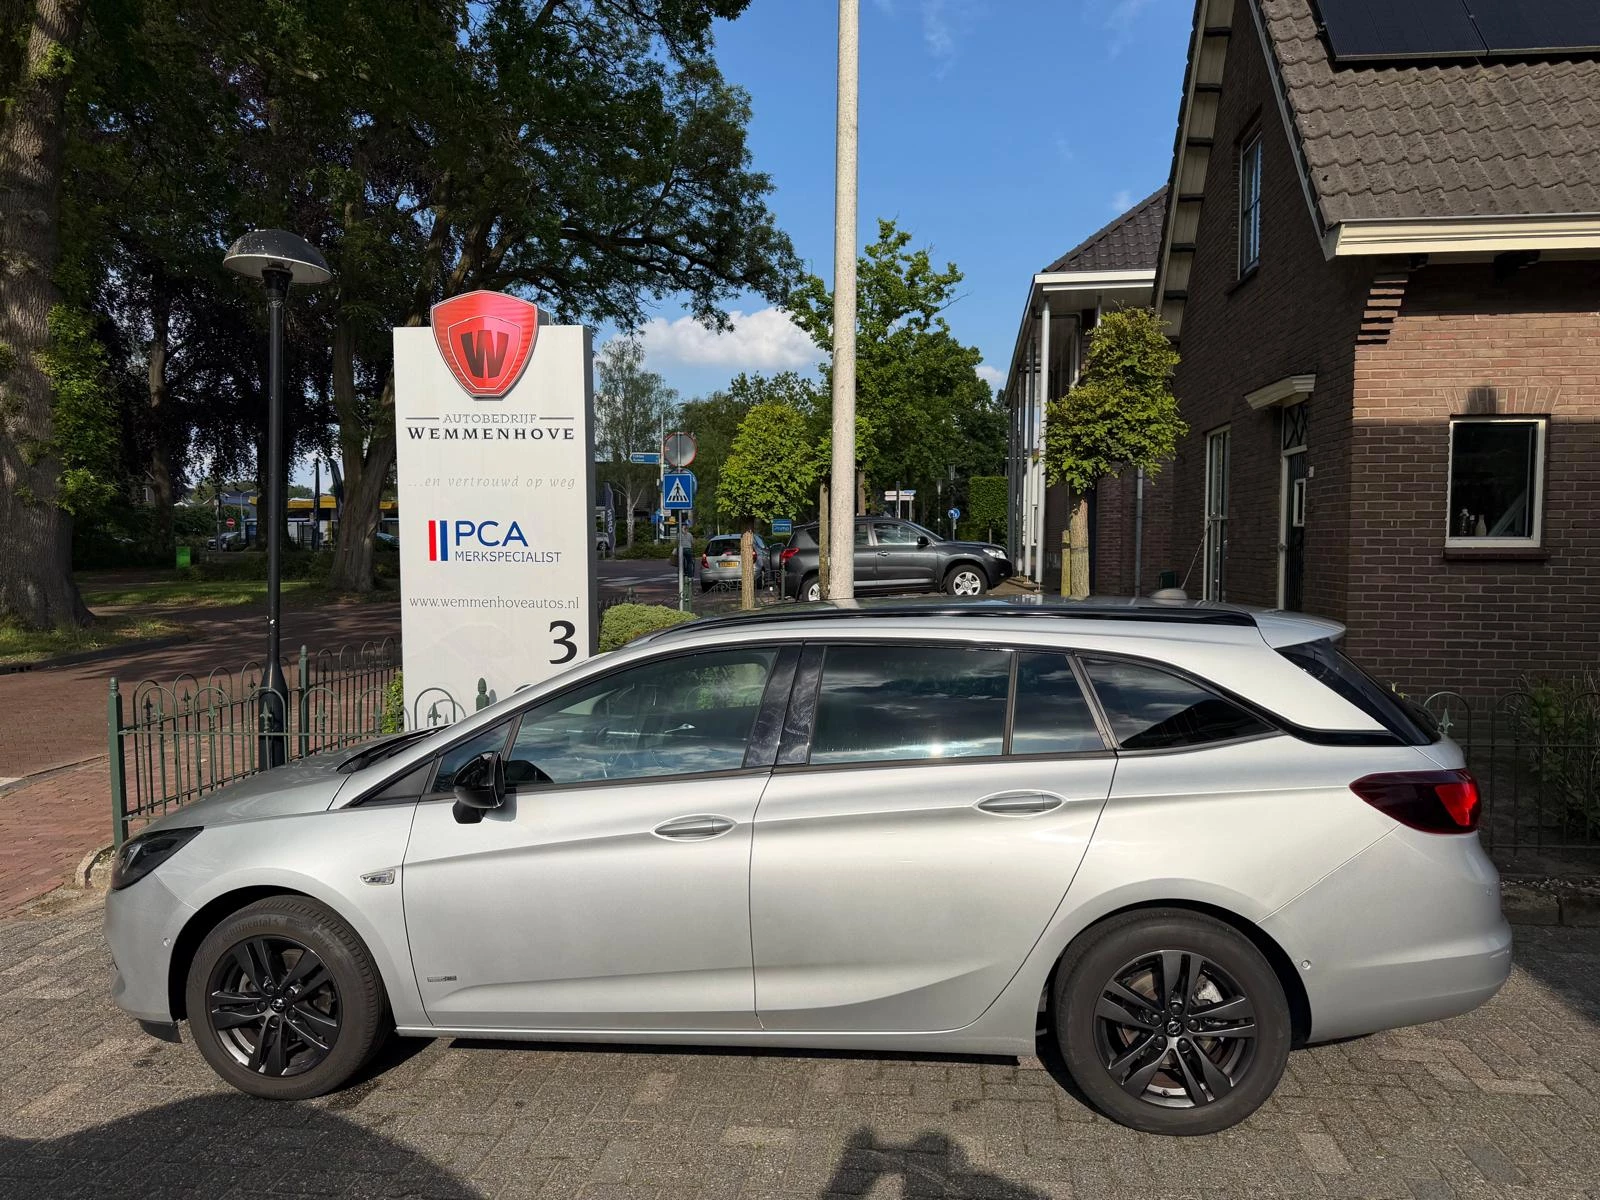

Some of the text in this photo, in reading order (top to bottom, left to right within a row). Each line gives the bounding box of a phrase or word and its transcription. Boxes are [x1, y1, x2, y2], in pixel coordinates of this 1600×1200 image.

[460, 329, 510, 379] W
[442, 413, 538, 425] AUTOBEDRIJF
[407, 427, 575, 440] WEMMENHOVE
[447, 475, 520, 488] vertrouwd
[526, 477, 543, 490] op
[549, 477, 576, 490] weg
[454, 520, 529, 547] PCA
[454, 550, 562, 563] MERKSPECIALIST
[409, 595, 580, 609] www.wemmenhoveautos.nl
[548, 619, 578, 665] 3
